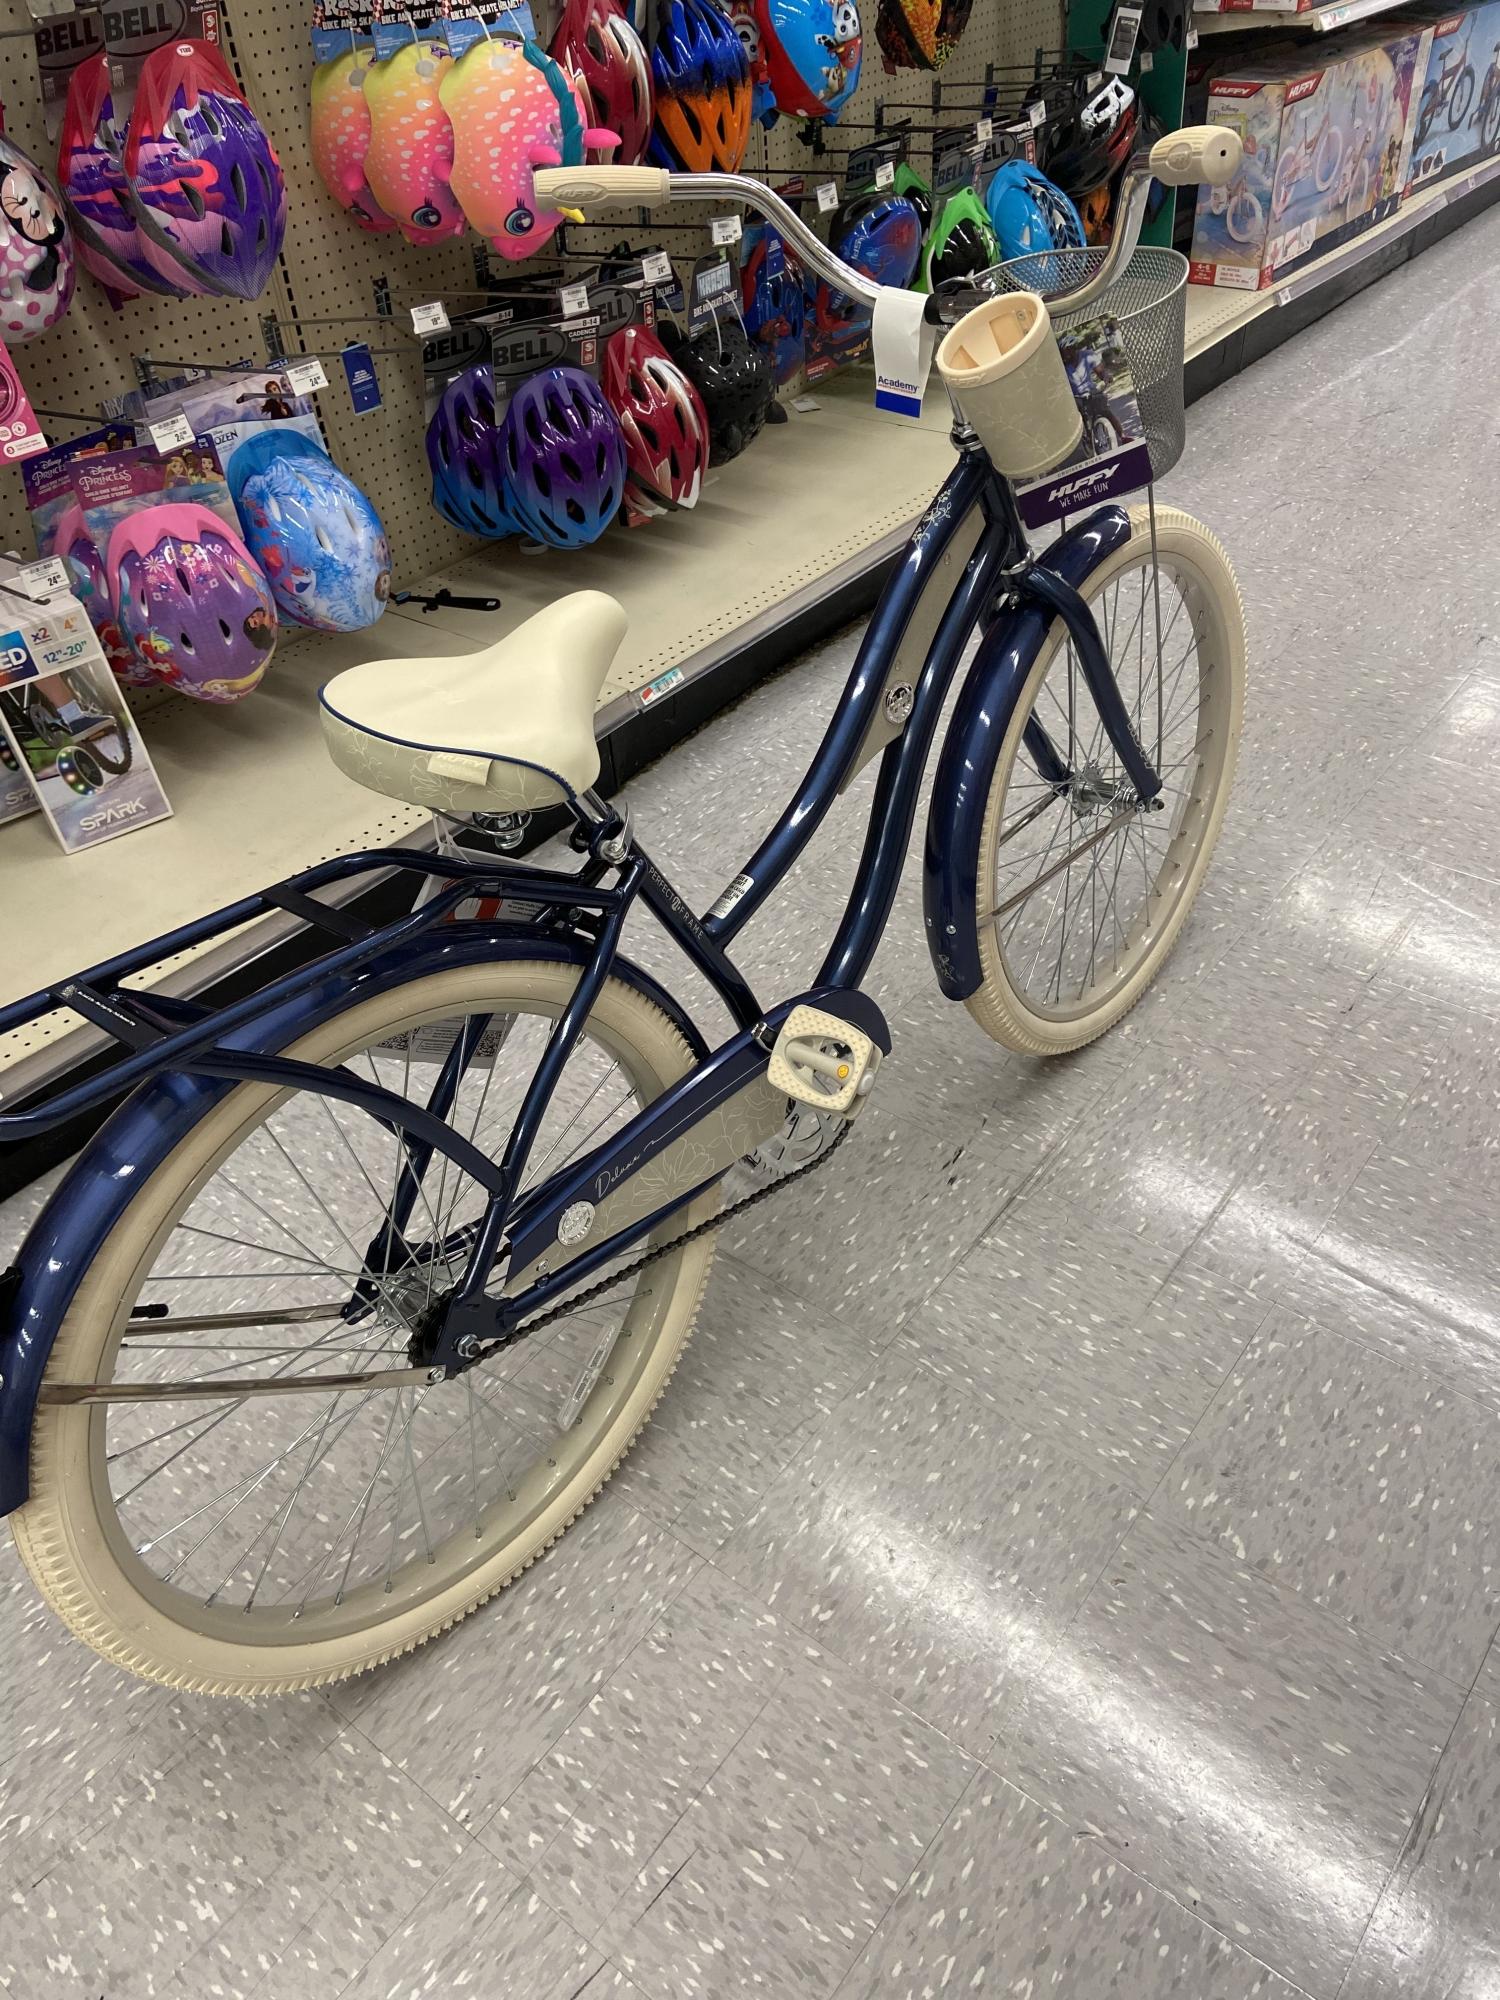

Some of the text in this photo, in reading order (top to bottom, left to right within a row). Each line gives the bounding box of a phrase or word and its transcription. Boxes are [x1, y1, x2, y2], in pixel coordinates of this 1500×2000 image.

[103, 3, 173, 43] BELL
[381, 14, 396, 24] BIKE
[450, 10, 465, 20] BIKE
[480, 3, 498, 15] SKATE
[35, 17, 99, 57] BELL
[322, 21, 340, 31] BIKE
[1213, 87, 1251, 95] HUFFY
[1288, 79, 1317, 98] HUFFY
[568, 328, 597, 339] CADENCE
[423, 332, 475, 364] BELL
[493, 338, 553, 368] BELL
[878, 375, 918, 394] Academy
[214, 428, 239, 445] OZEN
[32, 463, 67, 487] PRINCE
[87, 465, 117, 476] Disney
[1048, 463, 1120, 502] HUFFY
[1060, 481, 1110, 509] WE MAKE FUN
[79, 797, 146, 831] SPARK
[649, 866, 675, 901] PERFECT
[680, 907, 704, 938] FRAME
[595, 1154, 641, 1199] Deluxe
